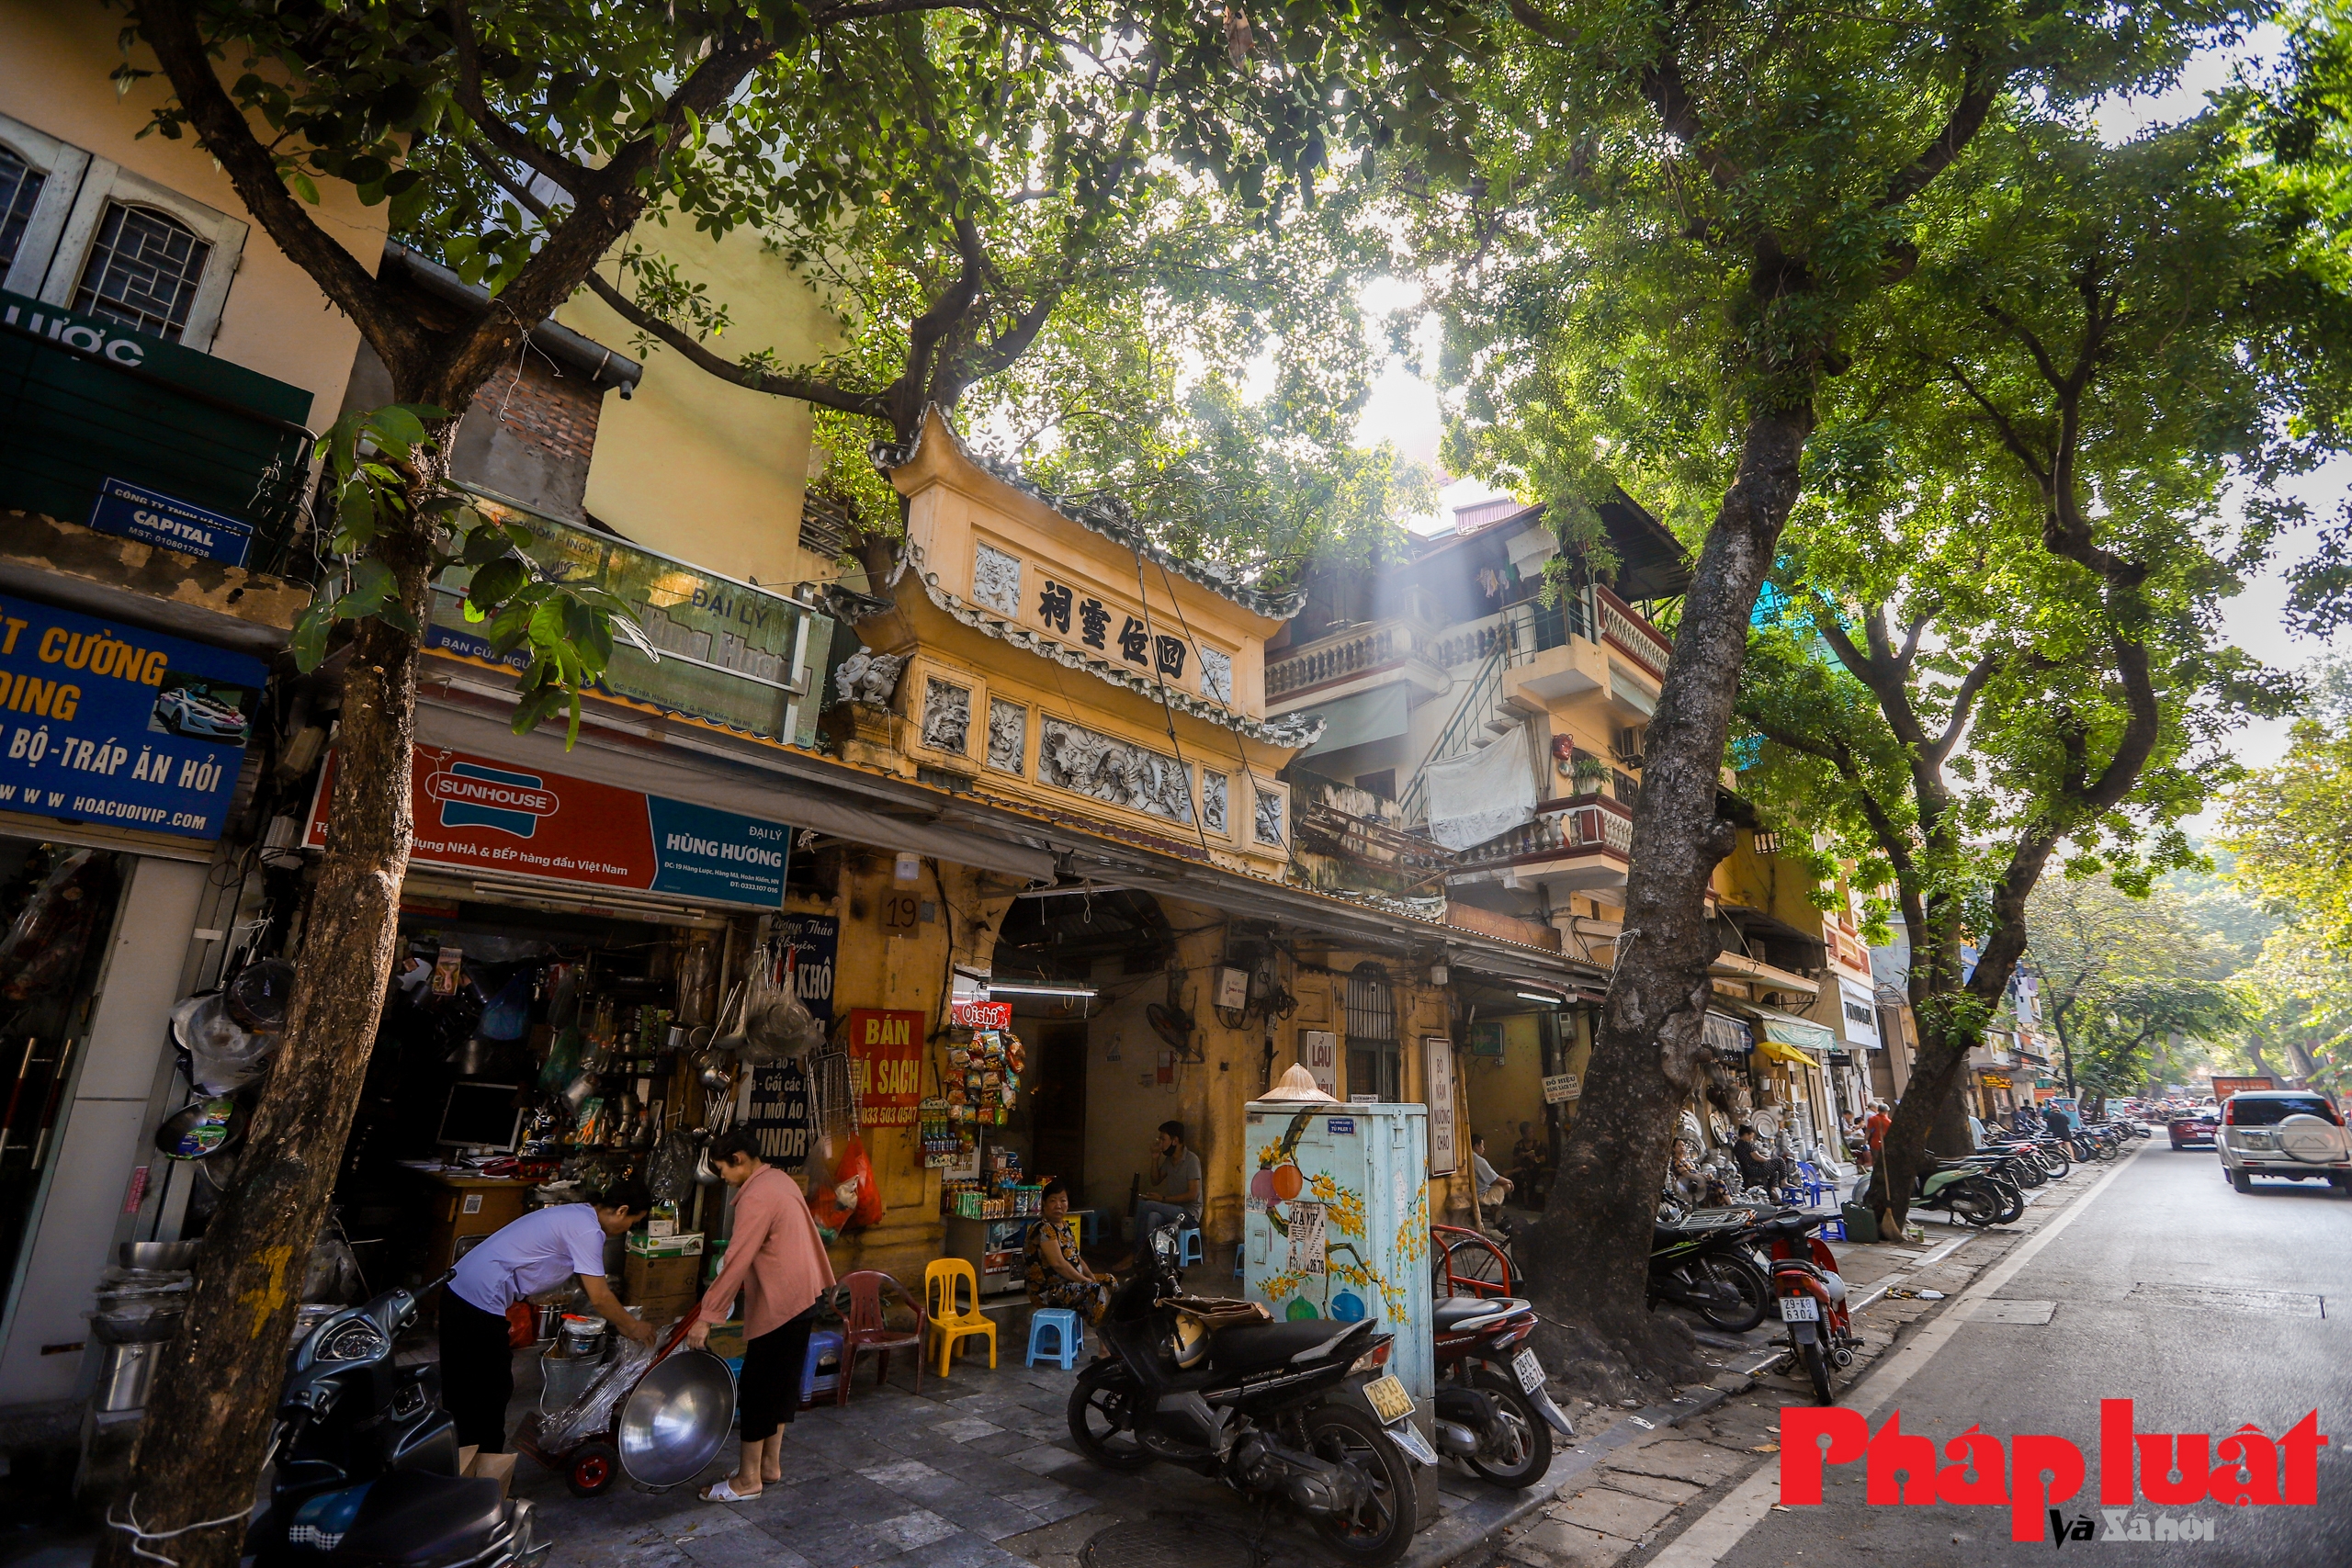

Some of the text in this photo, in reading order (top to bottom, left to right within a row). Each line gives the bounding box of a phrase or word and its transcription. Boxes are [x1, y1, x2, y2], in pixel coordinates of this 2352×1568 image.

[114, 488, 149, 504] CÔNG
[151, 500, 165, 509] TY
[128, 526, 210, 558] MST: 0108017538
[133, 510, 214, 547] CAPITAL
[566, 538, 595, 555] INOX
[691, 587, 769, 629] ĐẠI LÝ
[39, 626, 168, 687] CƯỜNG
[441, 637, 469, 653] BẠN
[131, 745, 173, 784] ĂN
[178, 753, 222, 793] HỎI
[438, 779, 548, 809] SUNHOUSE
[749, 825, 783, 841] ĐẠI LÝ
[447, 842, 478, 856] NHÀ
[480, 847, 491, 857] &
[492, 846, 518, 861] BẾP
[519, 852, 551, 867] hàng
[552, 856, 575, 869] đầu
[577, 860, 601, 874] Việt
[602, 863, 628, 875] Nam
[666, 832, 782, 868] HÙNG HƯƠNG
[886, 897, 916, 928] 19
[796, 955, 831, 1000] KHÔ
[865, 1014, 910, 1045] BÁN
[962, 1004, 999, 1025] Oishi
[1312, 1036, 1331, 1068] LẨU
[764, 1073, 781, 1092] Gối
[784, 1077, 799, 1092] các
[877, 1059, 920, 1102] SẠCH
[879, 1106, 897, 1124] 503
[898, 1106, 918, 1123] 0547
[1786, 1309, 1814, 1320] 6302
